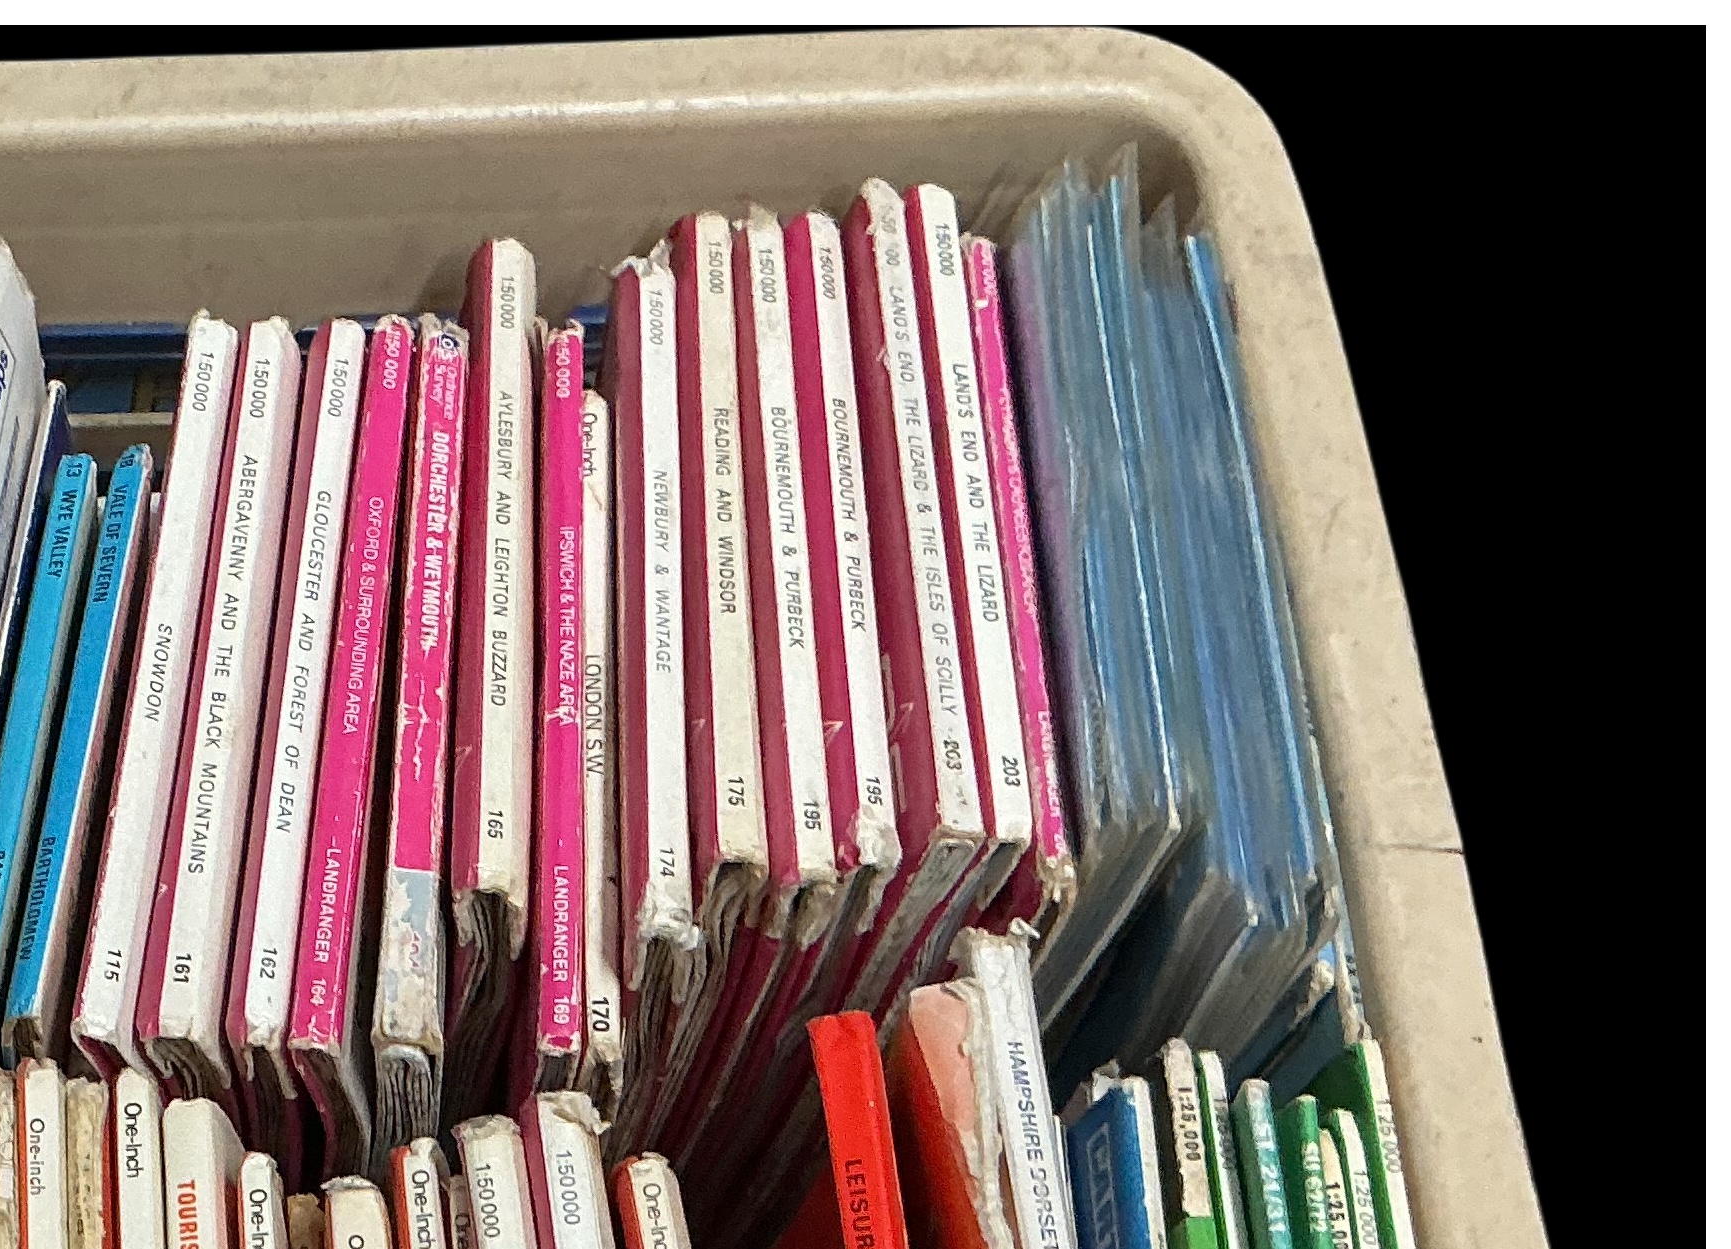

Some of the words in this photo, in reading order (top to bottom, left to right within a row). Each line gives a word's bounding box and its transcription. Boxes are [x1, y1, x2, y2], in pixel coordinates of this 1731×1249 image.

[953, 363, 974, 418] LAND'S
[496, 390, 514, 480] AYLESBURY
[961, 431, 979, 462] END
[57, 489, 78, 522] WYE
[223, 454, 258, 581] ABERGAVENNY
[495, 492, 511, 525] AND
[966, 475, 984, 509] AND
[47, 525, 71, 579] VALLEY
[971, 523, 990, 552] THE
[490, 536, 510, 620] LEIGHTON
[977, 565, 999, 623] LIZARD
[221, 593, 238, 631] AND
[215, 646, 235, 678] THE
[489, 630, 506, 708] BUZZARD
[206, 692, 226, 749] BLACK
[1002, 756, 1020, 787] 203
[188, 763, 218, 874] MOUNTAINS
[486, 810, 504, 840] 165
[172, 953, 192, 984] 161
[124, 1102, 140, 1178] One-Inch
[1177, 1086, 1199, 1162] 1:25,000
[29, 1118, 44, 1196] One-inch
